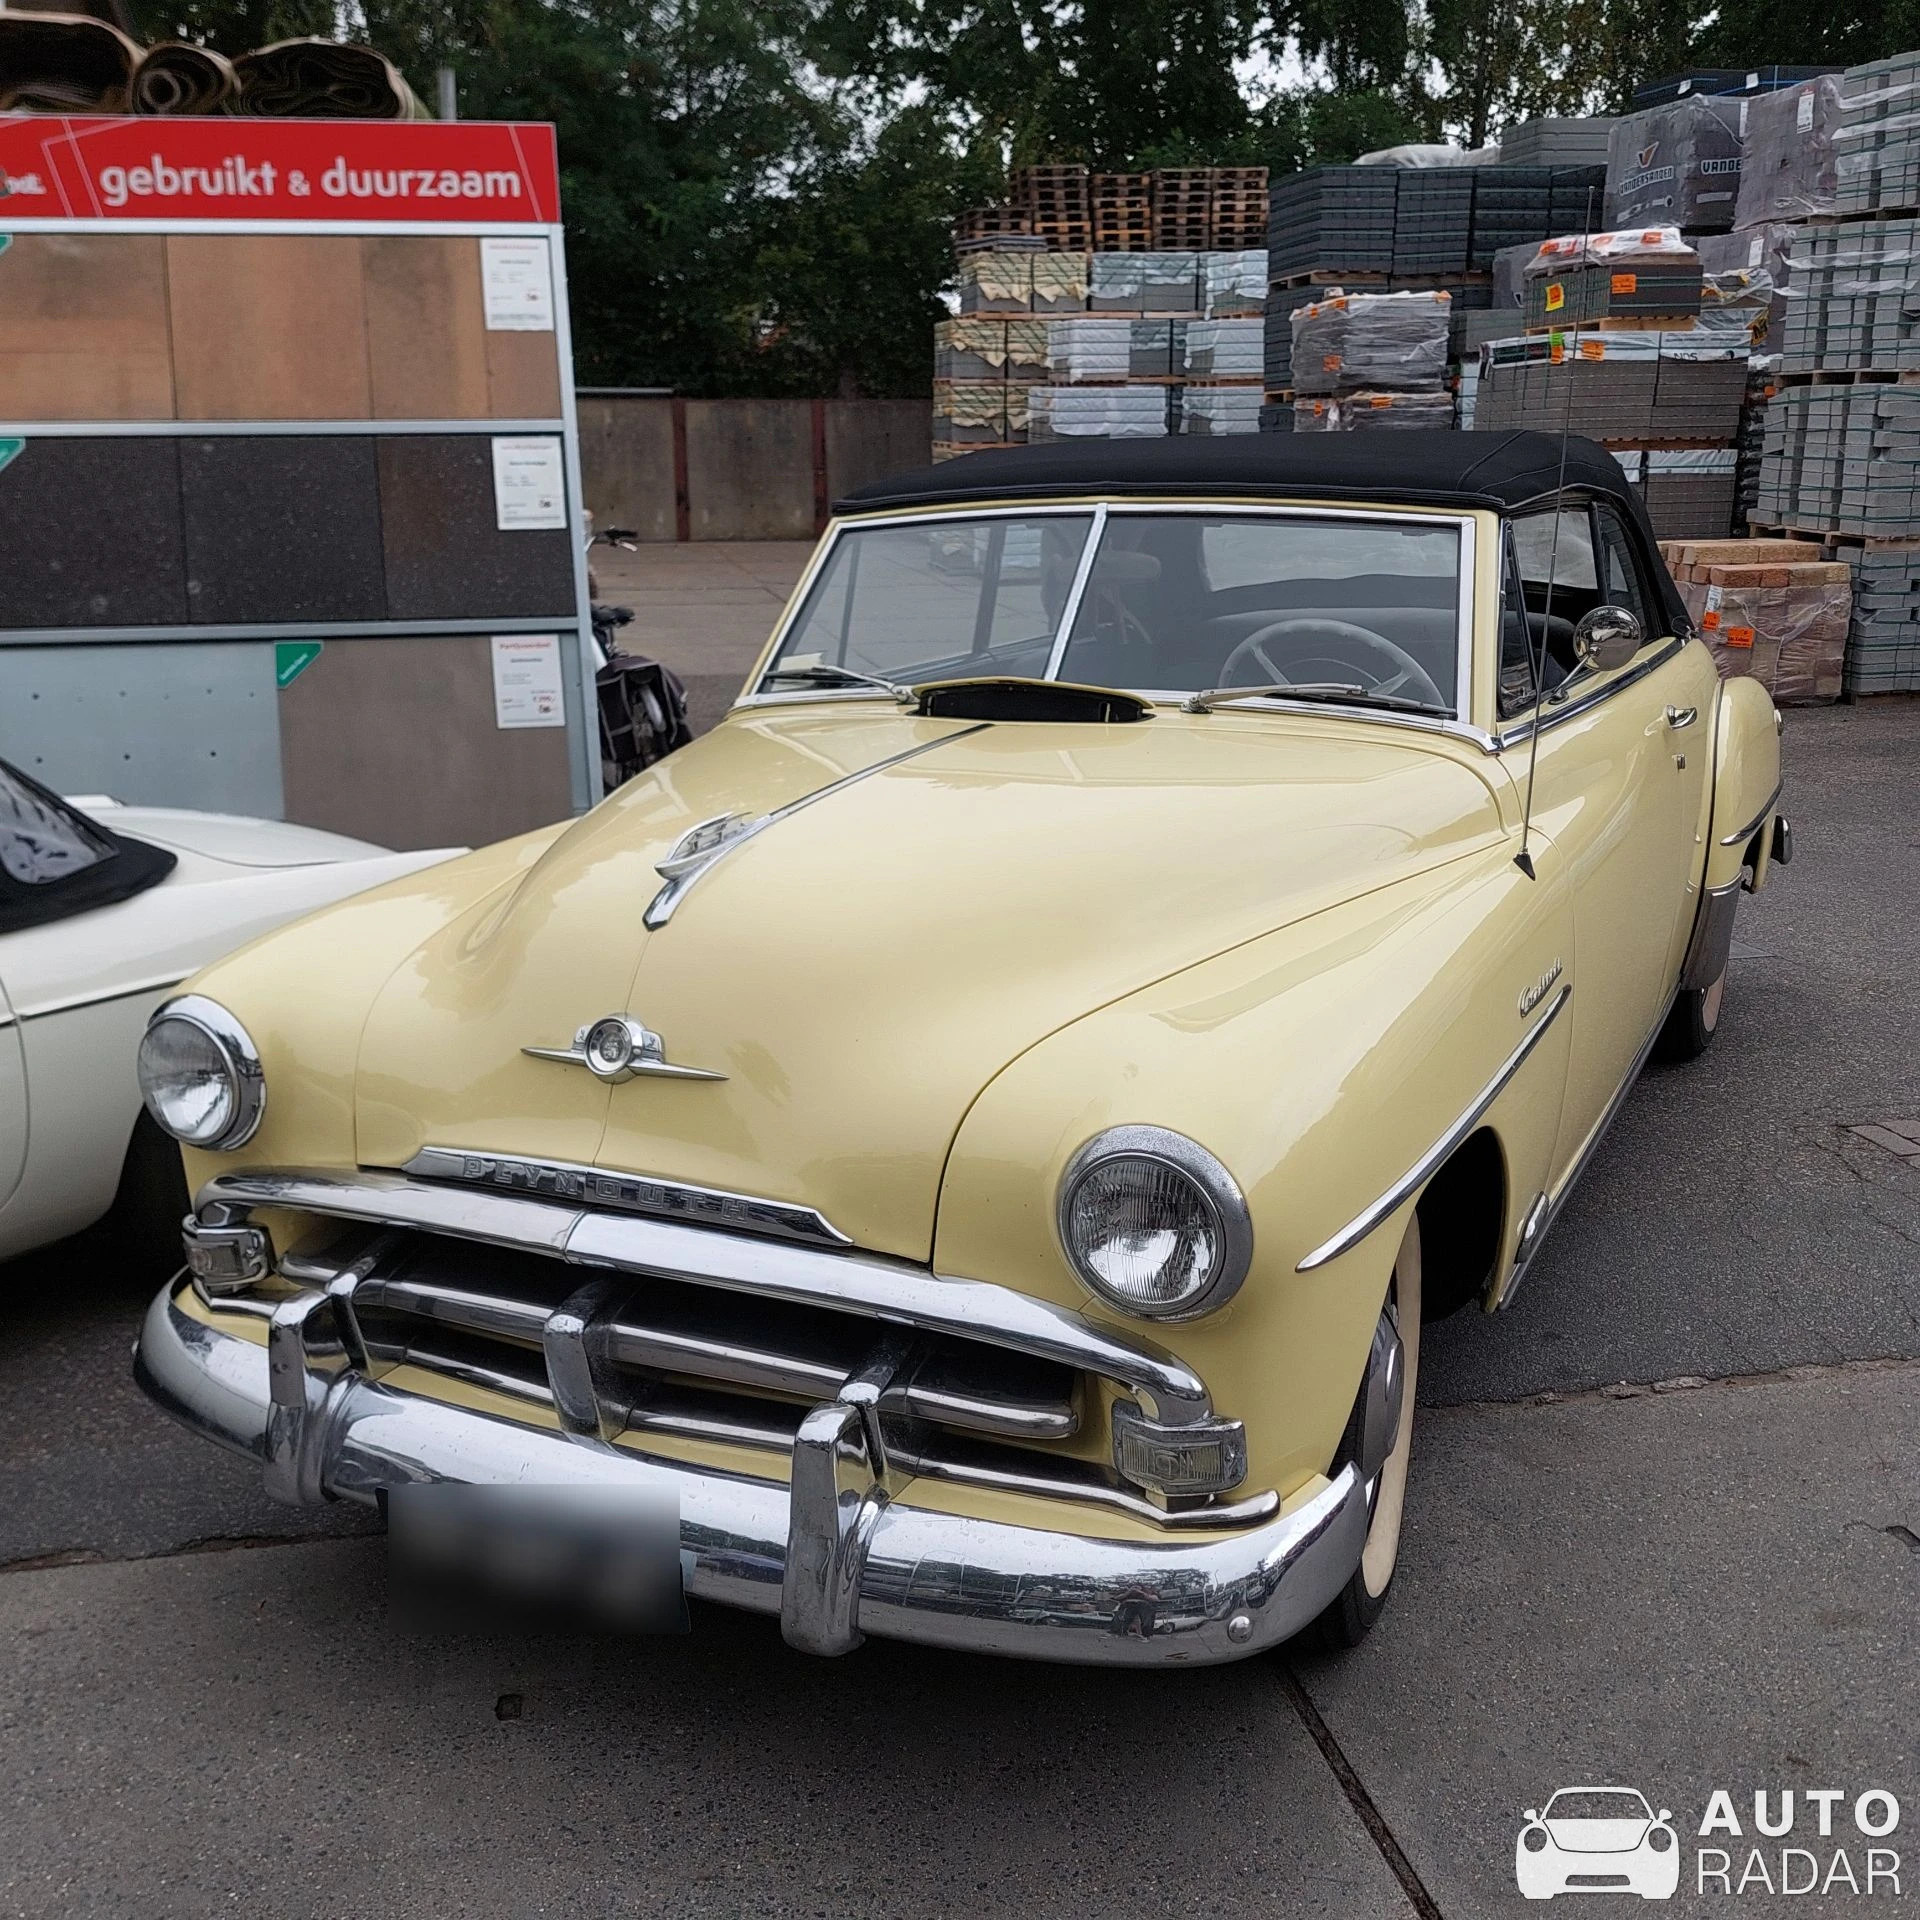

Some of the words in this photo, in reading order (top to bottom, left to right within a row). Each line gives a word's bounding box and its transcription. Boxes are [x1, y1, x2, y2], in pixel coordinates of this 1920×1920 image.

[100, 153, 277, 207] gebruikt
[288, 169, 311, 196] &
[321, 155, 521, 198] duurzaam
[463, 1155, 748, 1224] PLYMOUTH
